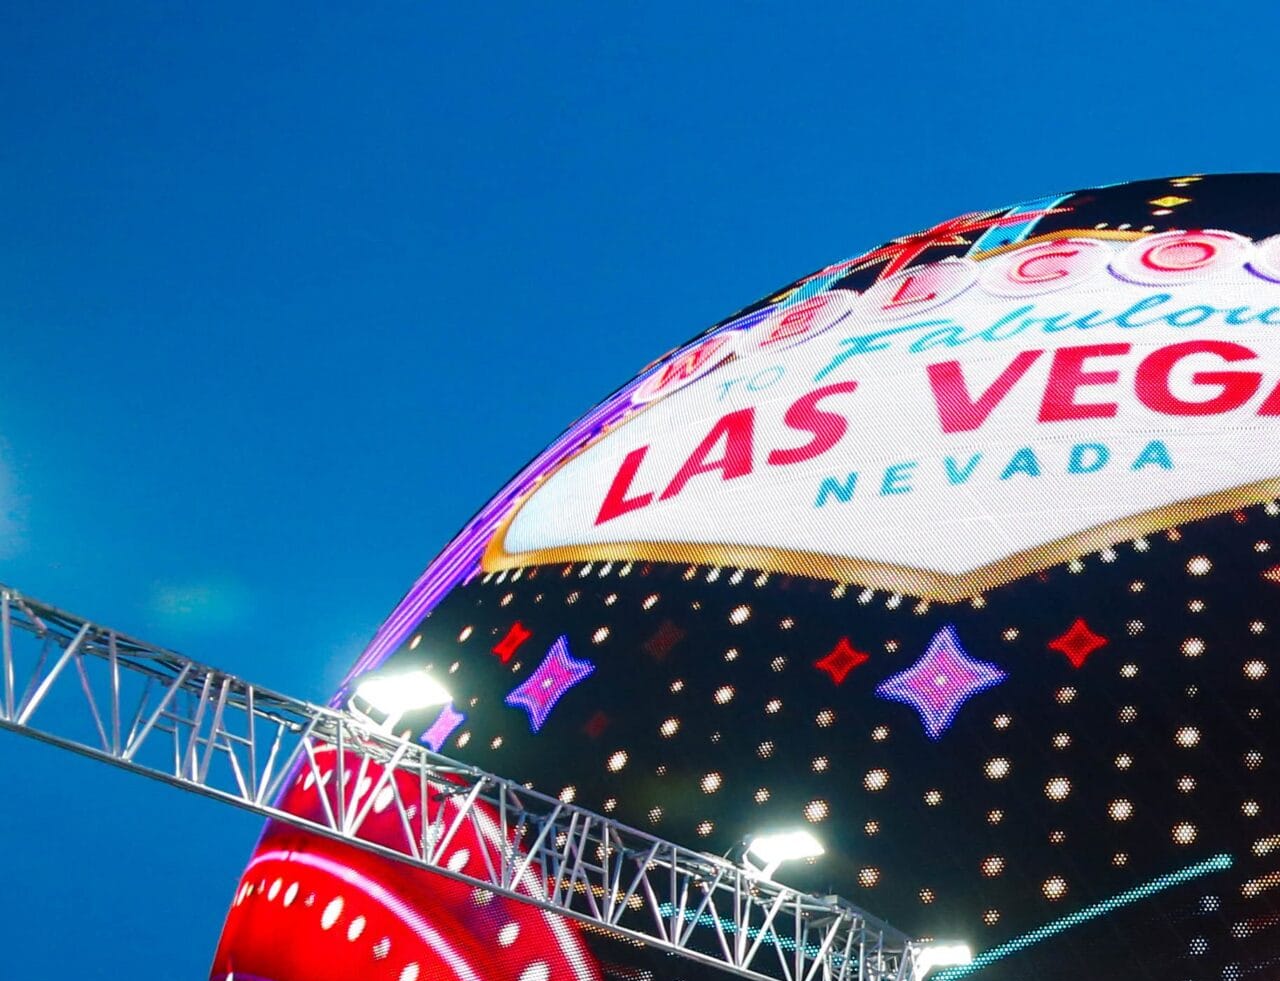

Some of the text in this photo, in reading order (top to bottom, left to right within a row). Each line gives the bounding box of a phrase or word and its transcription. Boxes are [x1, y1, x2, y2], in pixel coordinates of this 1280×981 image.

[716, 364, 784, 400] TO
[594, 381, 858, 526] LAS
[815, 440, 1175, 508] NEVADA
